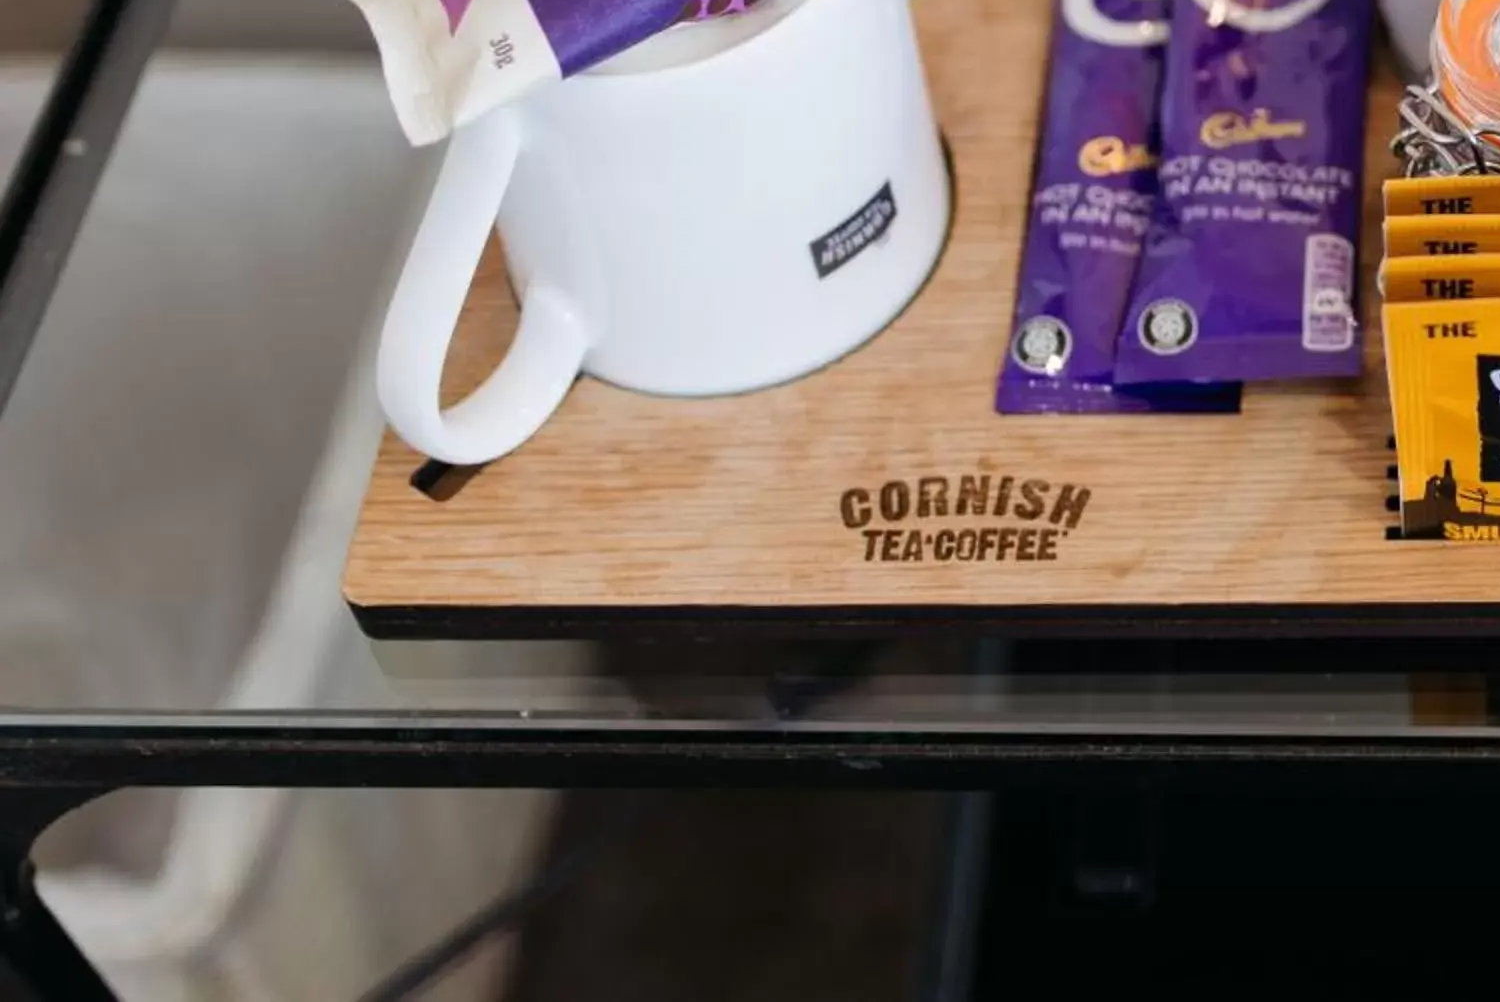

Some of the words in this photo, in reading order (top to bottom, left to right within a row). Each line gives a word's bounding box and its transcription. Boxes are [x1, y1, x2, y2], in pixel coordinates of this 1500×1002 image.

[1421, 197, 1474, 215] THE
[1424, 241, 1478, 255] THE
[1421, 279, 1475, 299] THE
[1423, 321, 1478, 339] THE
[840, 475, 1092, 529] CORNISH
